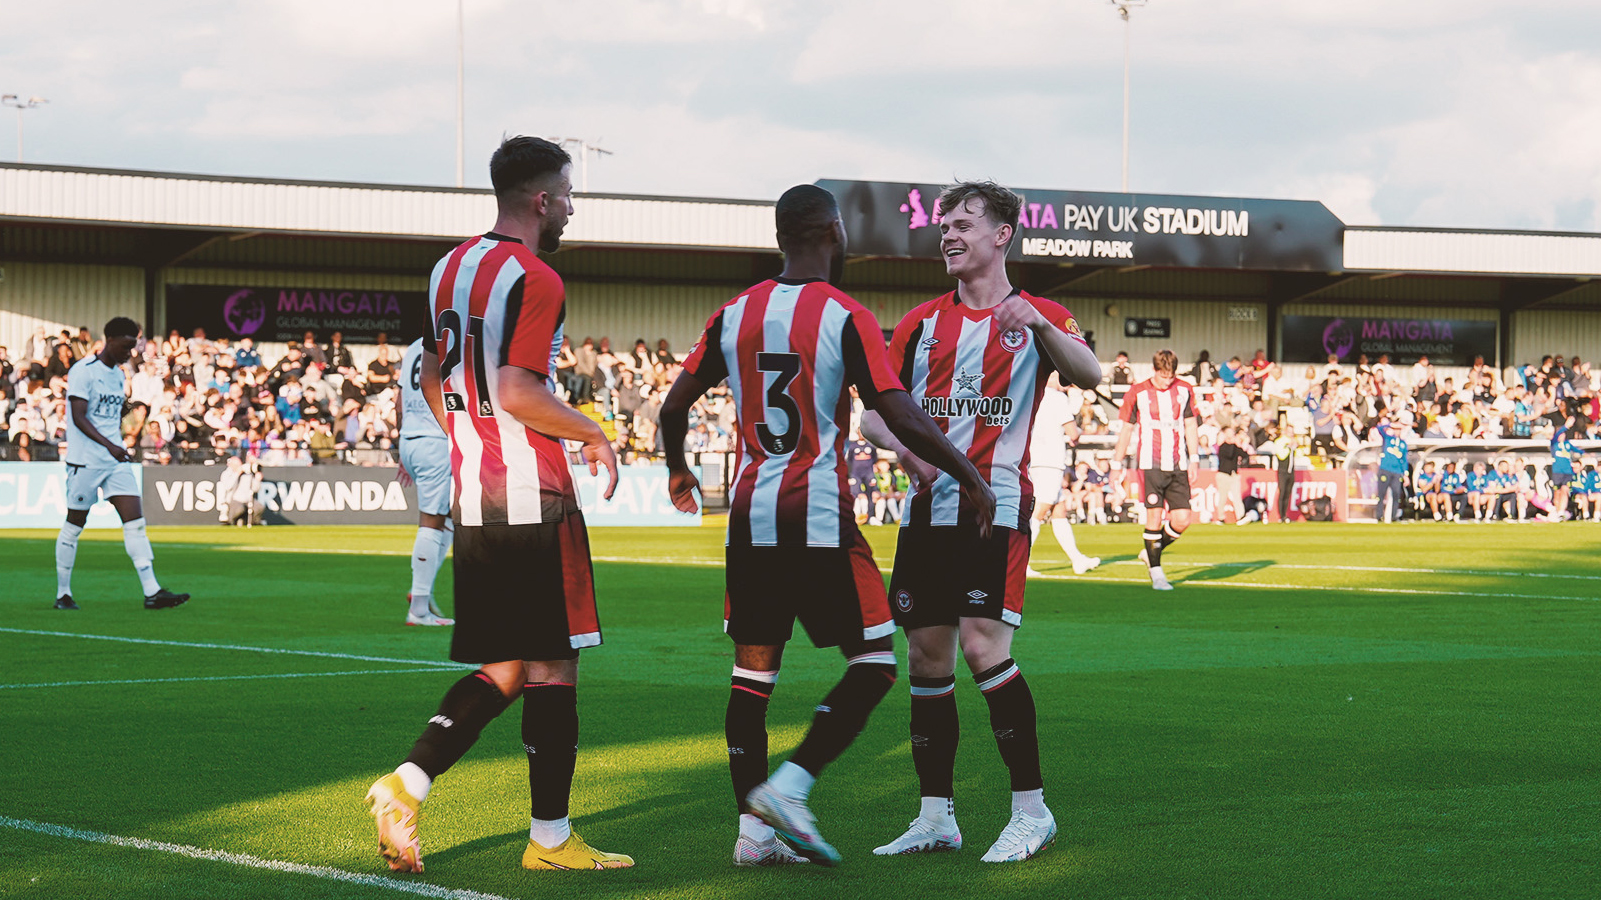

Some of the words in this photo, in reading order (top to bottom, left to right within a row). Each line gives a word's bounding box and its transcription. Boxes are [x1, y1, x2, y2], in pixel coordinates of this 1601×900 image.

[1064, 203, 1103, 231] PAY
[1107, 206, 1139, 233] UK
[1143, 207, 1249, 237] STADIUM
[1022, 238, 1091, 257] MEADOW
[1093, 240, 1133, 258] PARK
[277, 290, 400, 315] MANGATA
[276, 316, 320, 329] GLOBAL
[323, 317, 401, 330] MANAGEMENT
[1361, 320, 1453, 340] MANGATA
[1360, 341, 1393, 353] GLOBAL
[754, 351, 803, 456] 3
[921, 397, 1013, 417] HOLLYWOOD
[986, 415, 1010, 426] bets
[257, 480, 408, 512] RWANDA
